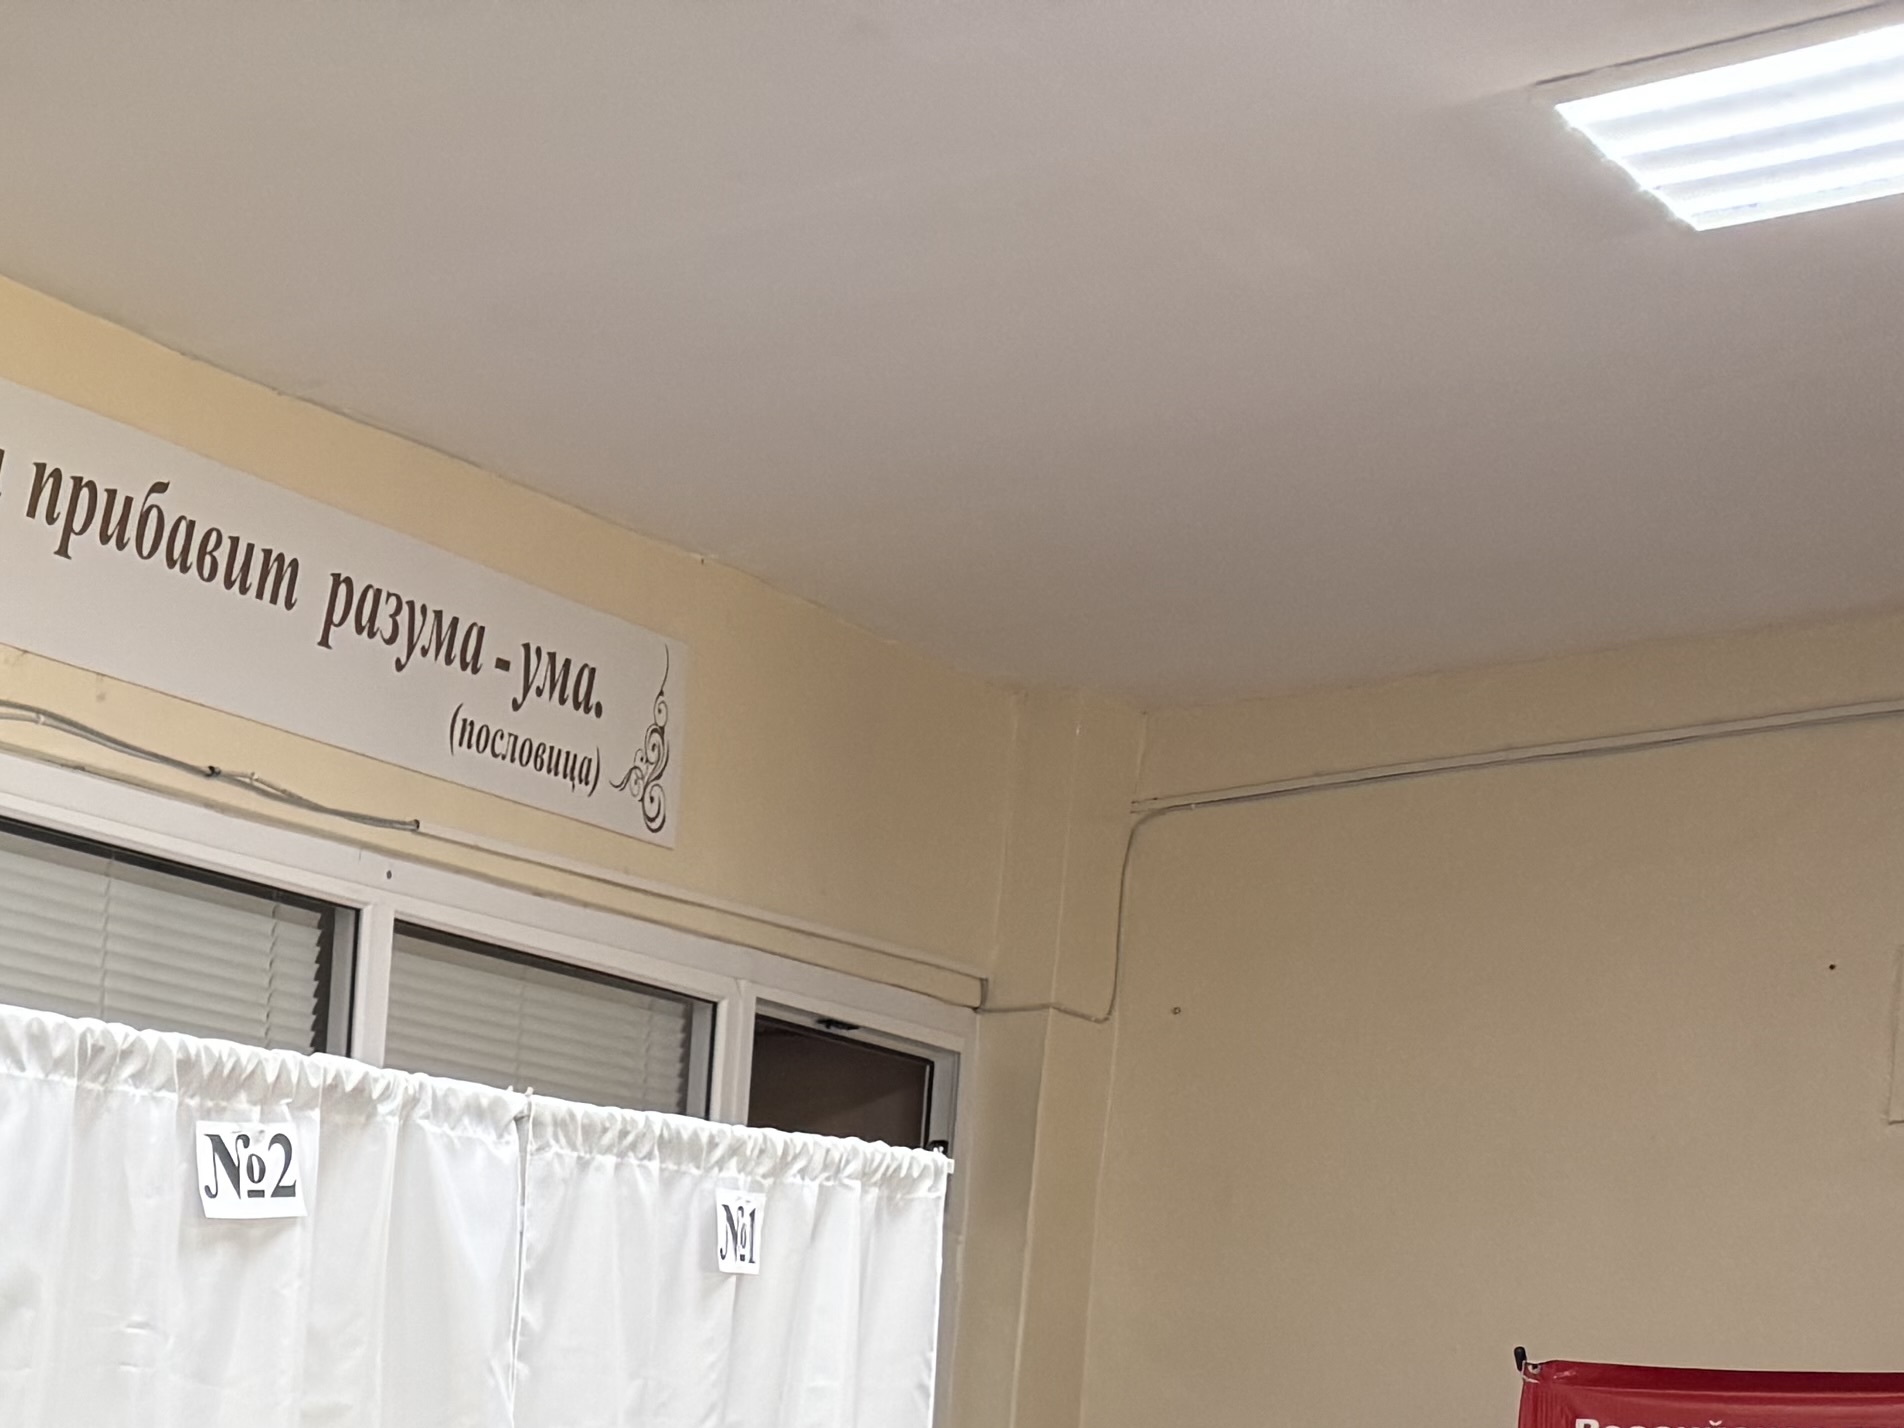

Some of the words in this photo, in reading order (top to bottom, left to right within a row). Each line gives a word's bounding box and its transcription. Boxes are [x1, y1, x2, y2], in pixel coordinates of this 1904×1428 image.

[24, 451, 300, 612] прибавит
[449, 703, 600, 797] (пословица)
[204, 1132, 296, 1201] №2
[720, 1202, 757, 1267] №1
